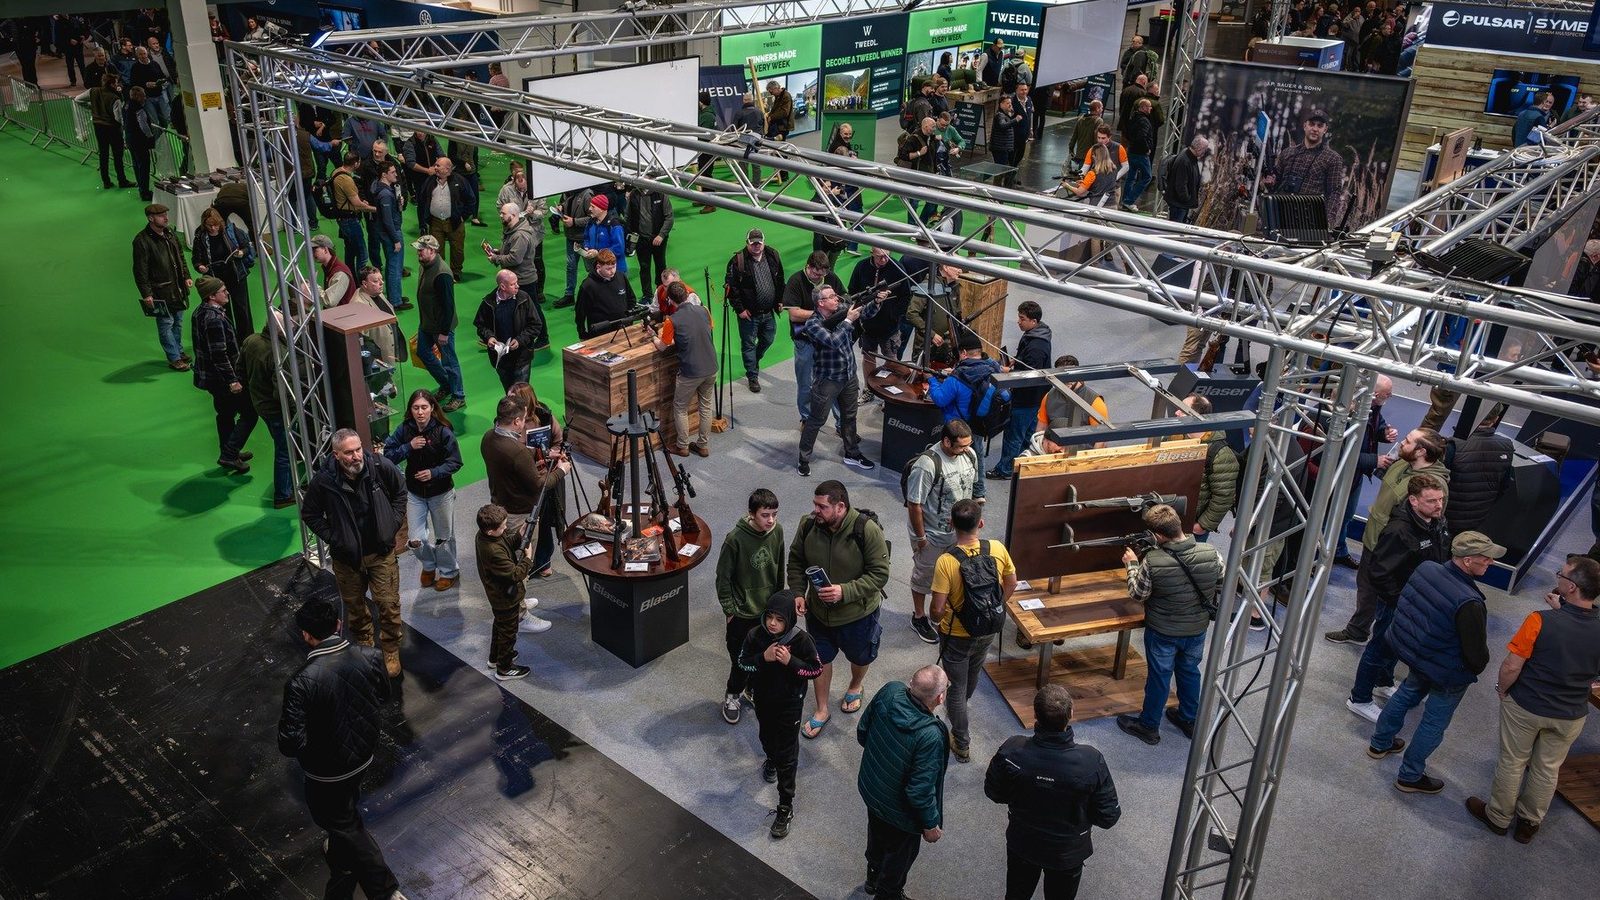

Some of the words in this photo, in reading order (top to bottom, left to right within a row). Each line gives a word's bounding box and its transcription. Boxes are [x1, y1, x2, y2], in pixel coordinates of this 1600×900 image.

[991, 12, 1040, 26] TWEEDL.
[1462, 14, 1526, 29] PULSAR
[929, 26, 953, 36] WINNERS
[953, 24, 968, 34] MADE
[931, 35, 947, 44] EVERY
[948, 34, 962, 42] WEEK
[778, 49, 797, 60] MADE
[826, 55, 851, 67] BECOME
[851, 55, 856, 64] A
[856, 52, 880, 63] TWEEDL
[880, 47, 903, 58] WINNER
[752, 62, 771, 73] VERY
[772, 59, 791, 69] WEEK
[1194, 385, 1250, 396] Blaser
[887, 417, 925, 436] Blaser
[1156, 450, 1201, 463] Blaser
[593, 582, 629, 609] Blaser
[639, 584, 684, 613] Blaser
